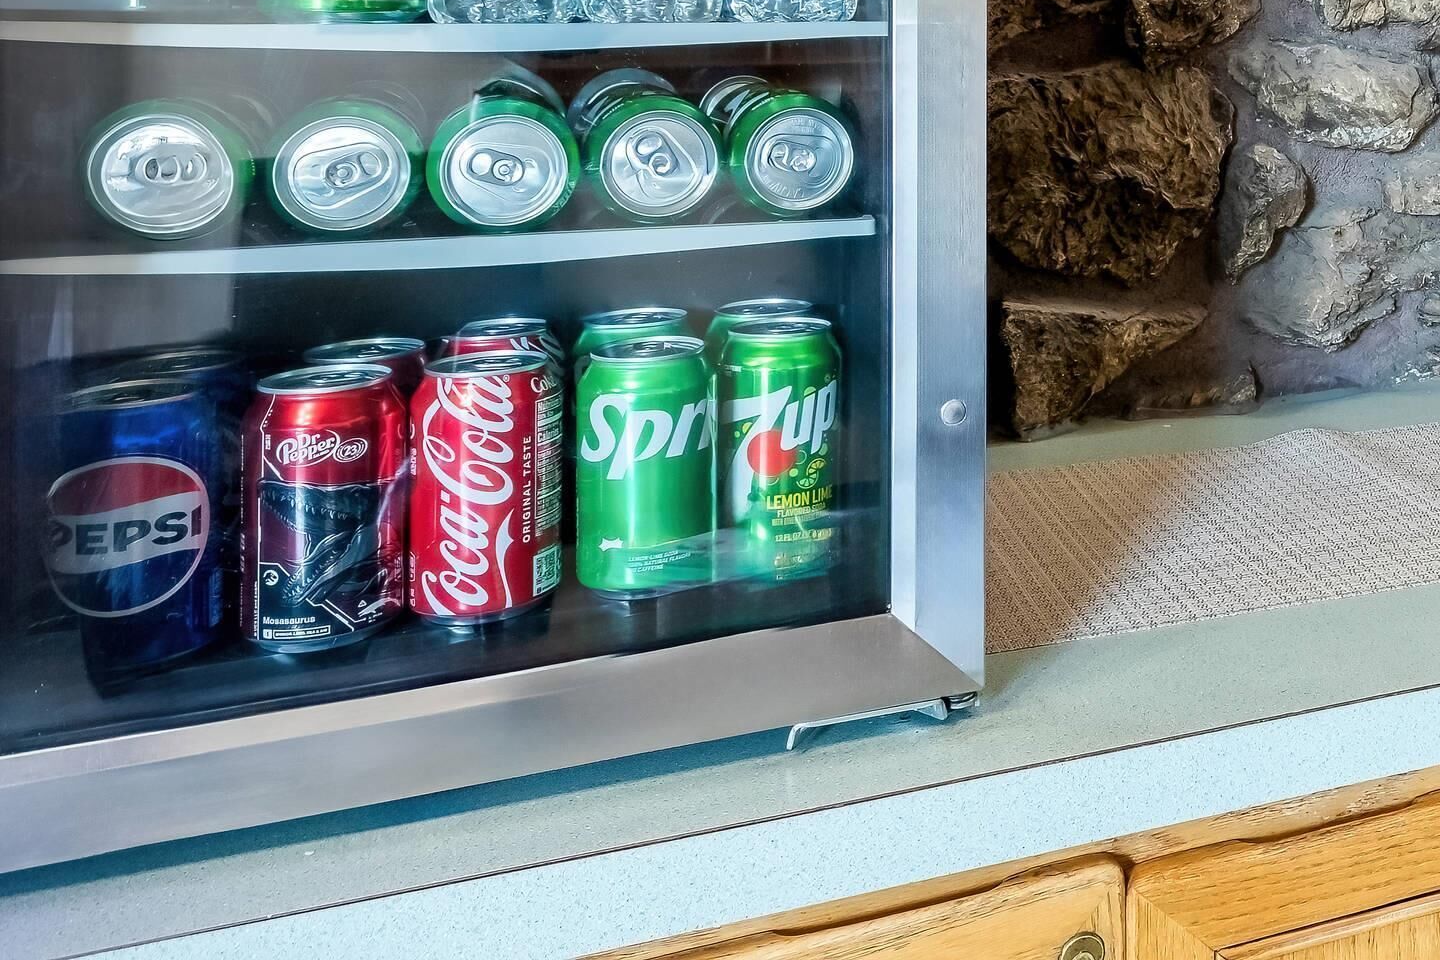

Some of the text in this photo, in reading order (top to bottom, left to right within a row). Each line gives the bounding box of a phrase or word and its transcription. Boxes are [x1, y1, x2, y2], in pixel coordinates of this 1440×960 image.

[298, 433, 321, 447] Dr
[279, 436, 335, 465] Pepper
[343, 446, 358, 456] 23
[522, 435, 532, 543] ORIGINAL TASTE
[766, 484, 833, 510] LEMON LIME
[262, 616, 316, 625] Mosasaurus
